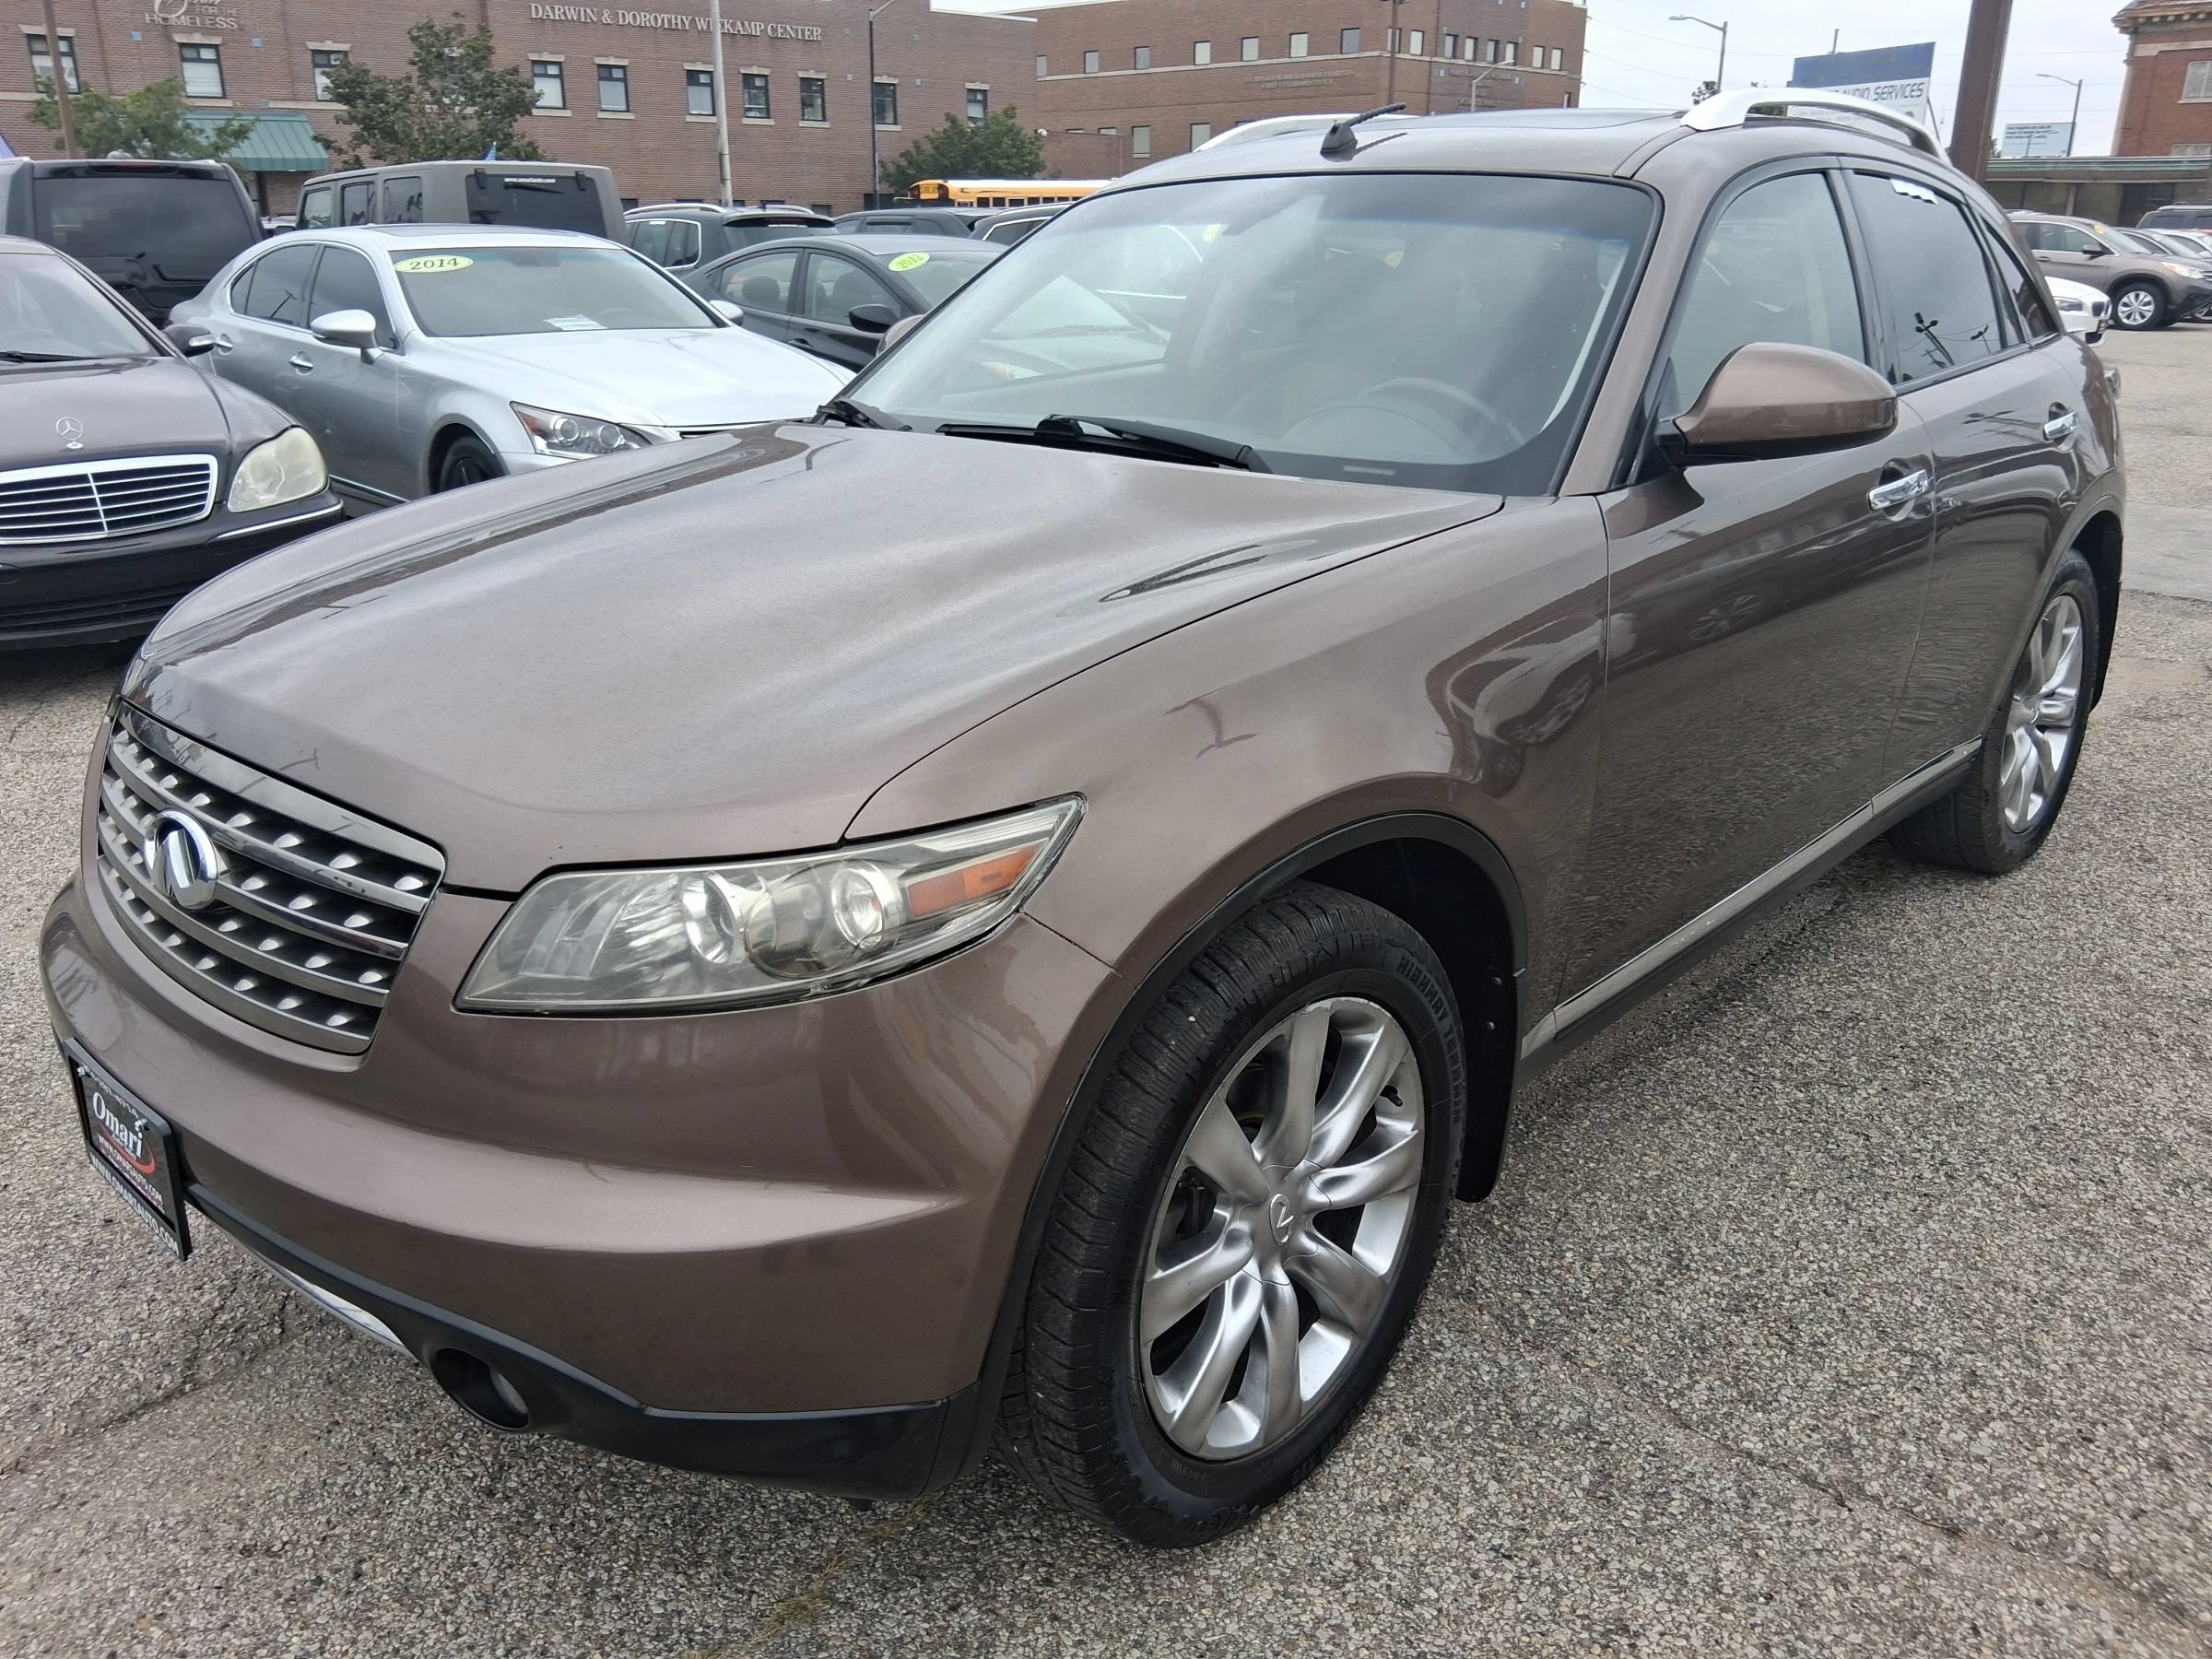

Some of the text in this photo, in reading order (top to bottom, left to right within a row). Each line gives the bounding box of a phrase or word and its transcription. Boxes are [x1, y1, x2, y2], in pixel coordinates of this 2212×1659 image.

[145, 13, 238, 29] HOMELESS
[530, 3, 597, 23] DARWIN
[602, 8, 615, 25] &
[617, 10, 692, 30] DOROTHY
[767, 23, 822, 41] CENTER
[1873, 81, 1925, 101] SERVICES
[409, 257, 459, 271] 2014
[897, 253, 924, 269] 2012
[92, 1091, 143, 1159] Omari
